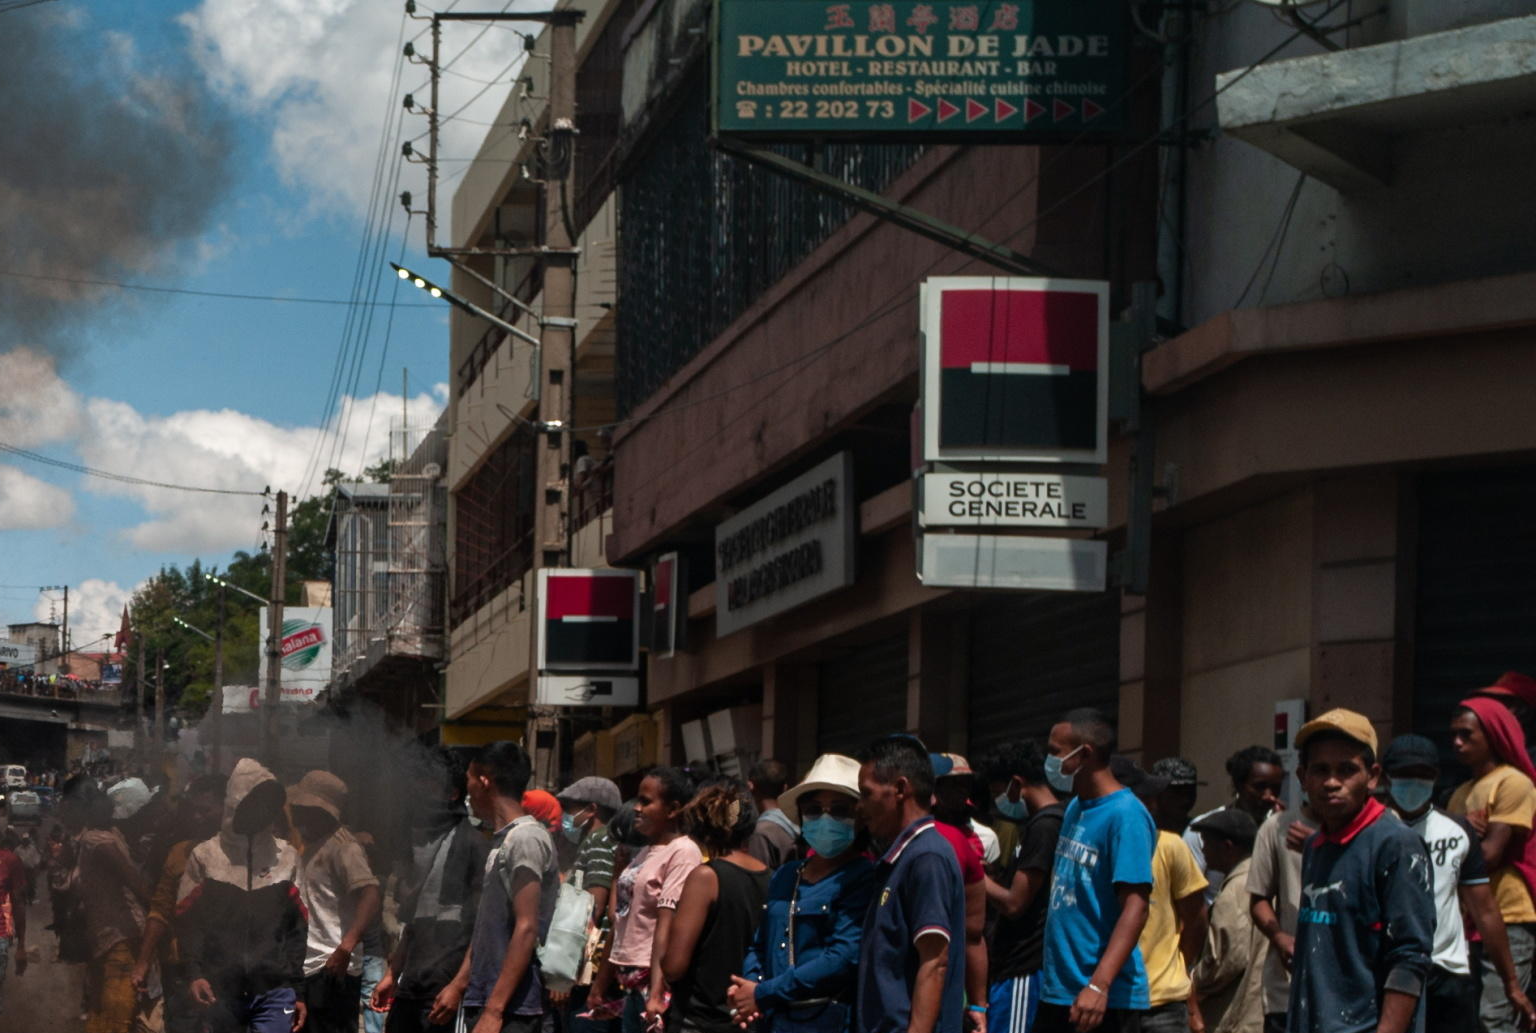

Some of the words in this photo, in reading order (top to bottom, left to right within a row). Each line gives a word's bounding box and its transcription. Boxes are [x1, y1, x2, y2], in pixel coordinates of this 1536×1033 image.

[737, 35, 934, 57] PAVILLON
[948, 35, 999, 57] DE
[1011, 35, 1109, 57] JADE
[786, 61, 852, 76] HOTEL
[868, 61, 1000, 76] RESTAURANT
[1017, 61, 1057, 76] BAR
[736, 80, 809, 96] Chambres
[812, 80, 903, 96] confortables
[915, 79, 987, 98] Spécialité
[990, 80, 1044, 96] cuisine
[1046, 80, 1107, 96] chinoise
[780, 101, 808, 118] 22
[815, 101, 858, 118] 202
[867, 101, 895, 118] 73
[949, 481, 1061, 498] SOCIETE
[949, 501, 1086, 519] GENERALE
